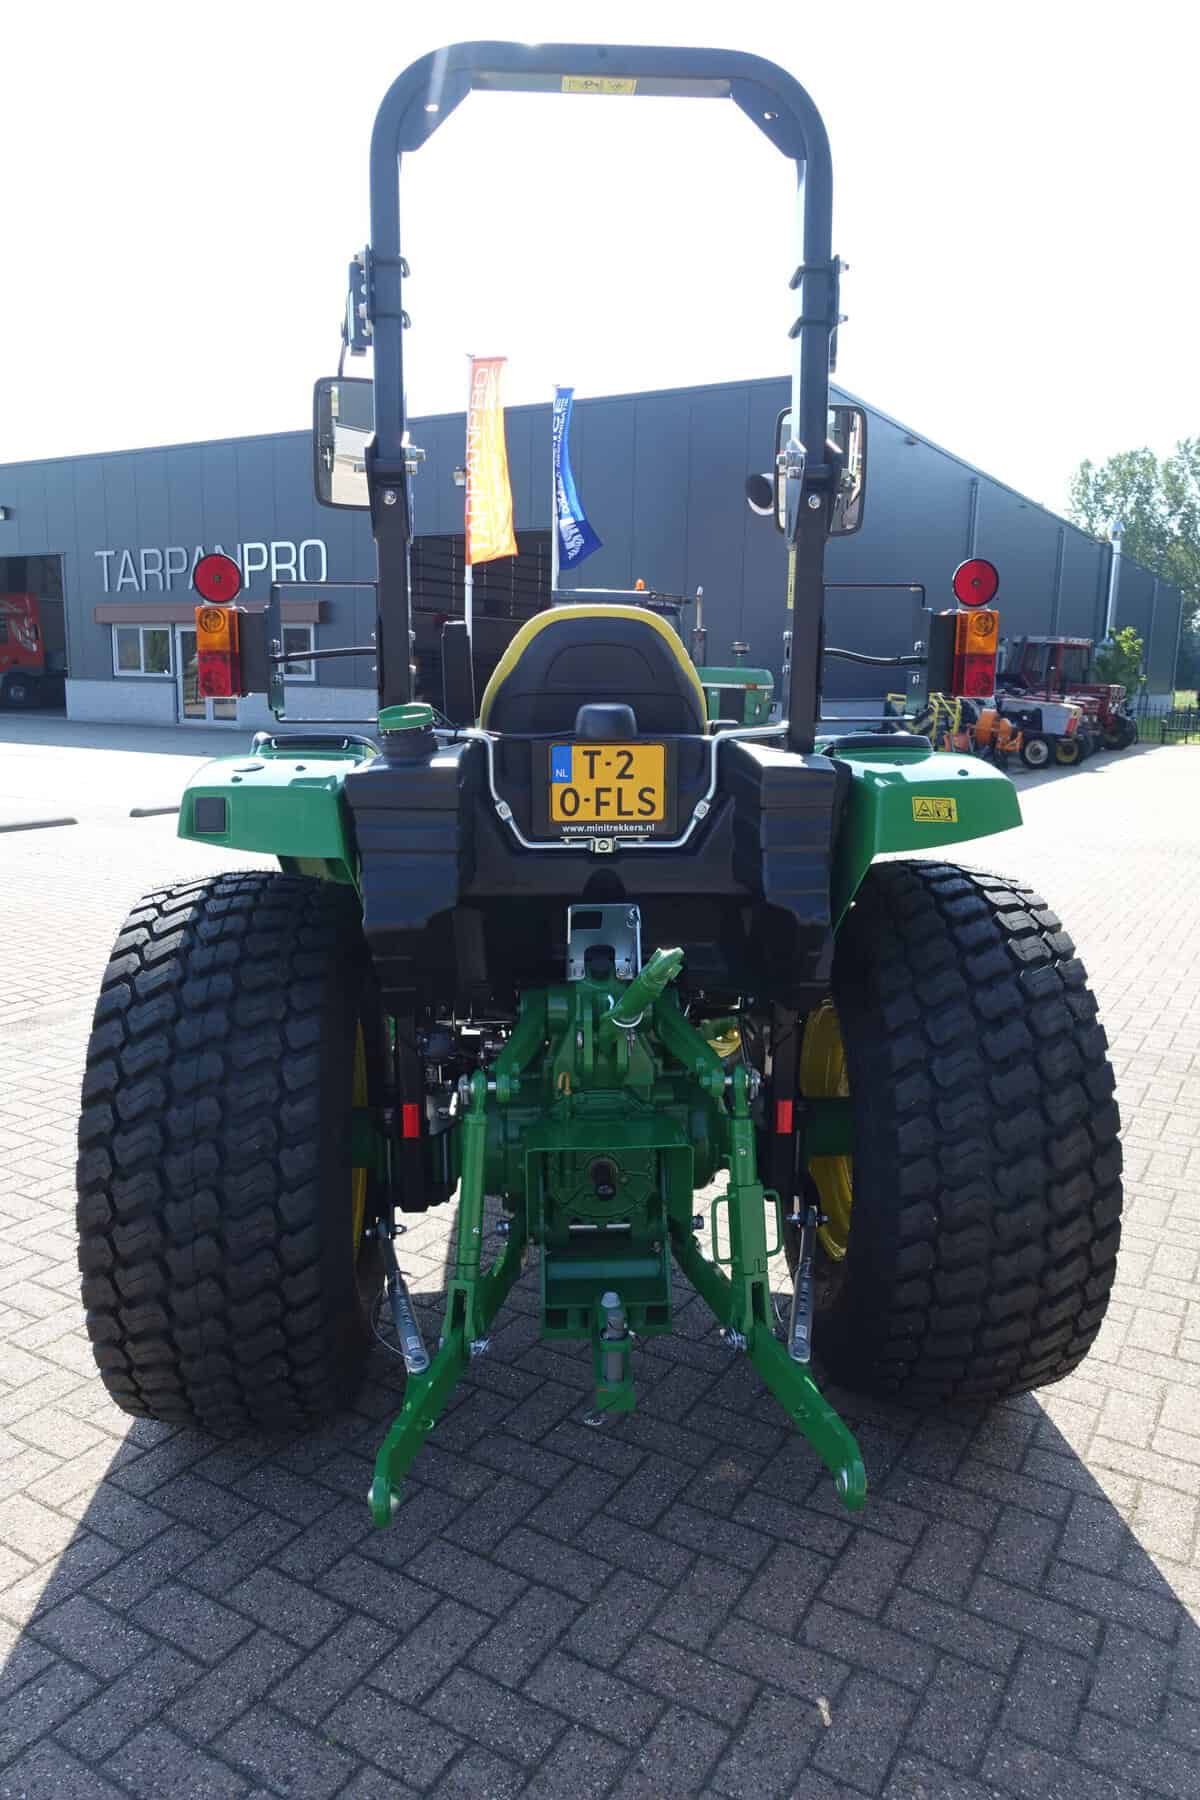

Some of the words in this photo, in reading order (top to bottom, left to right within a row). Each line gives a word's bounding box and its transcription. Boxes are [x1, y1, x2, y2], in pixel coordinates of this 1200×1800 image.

[582, 750, 634, 779] T-2
[555, 768, 569, 778] NL
[562, 823, 655, 833] www.minitrekkers.nl
